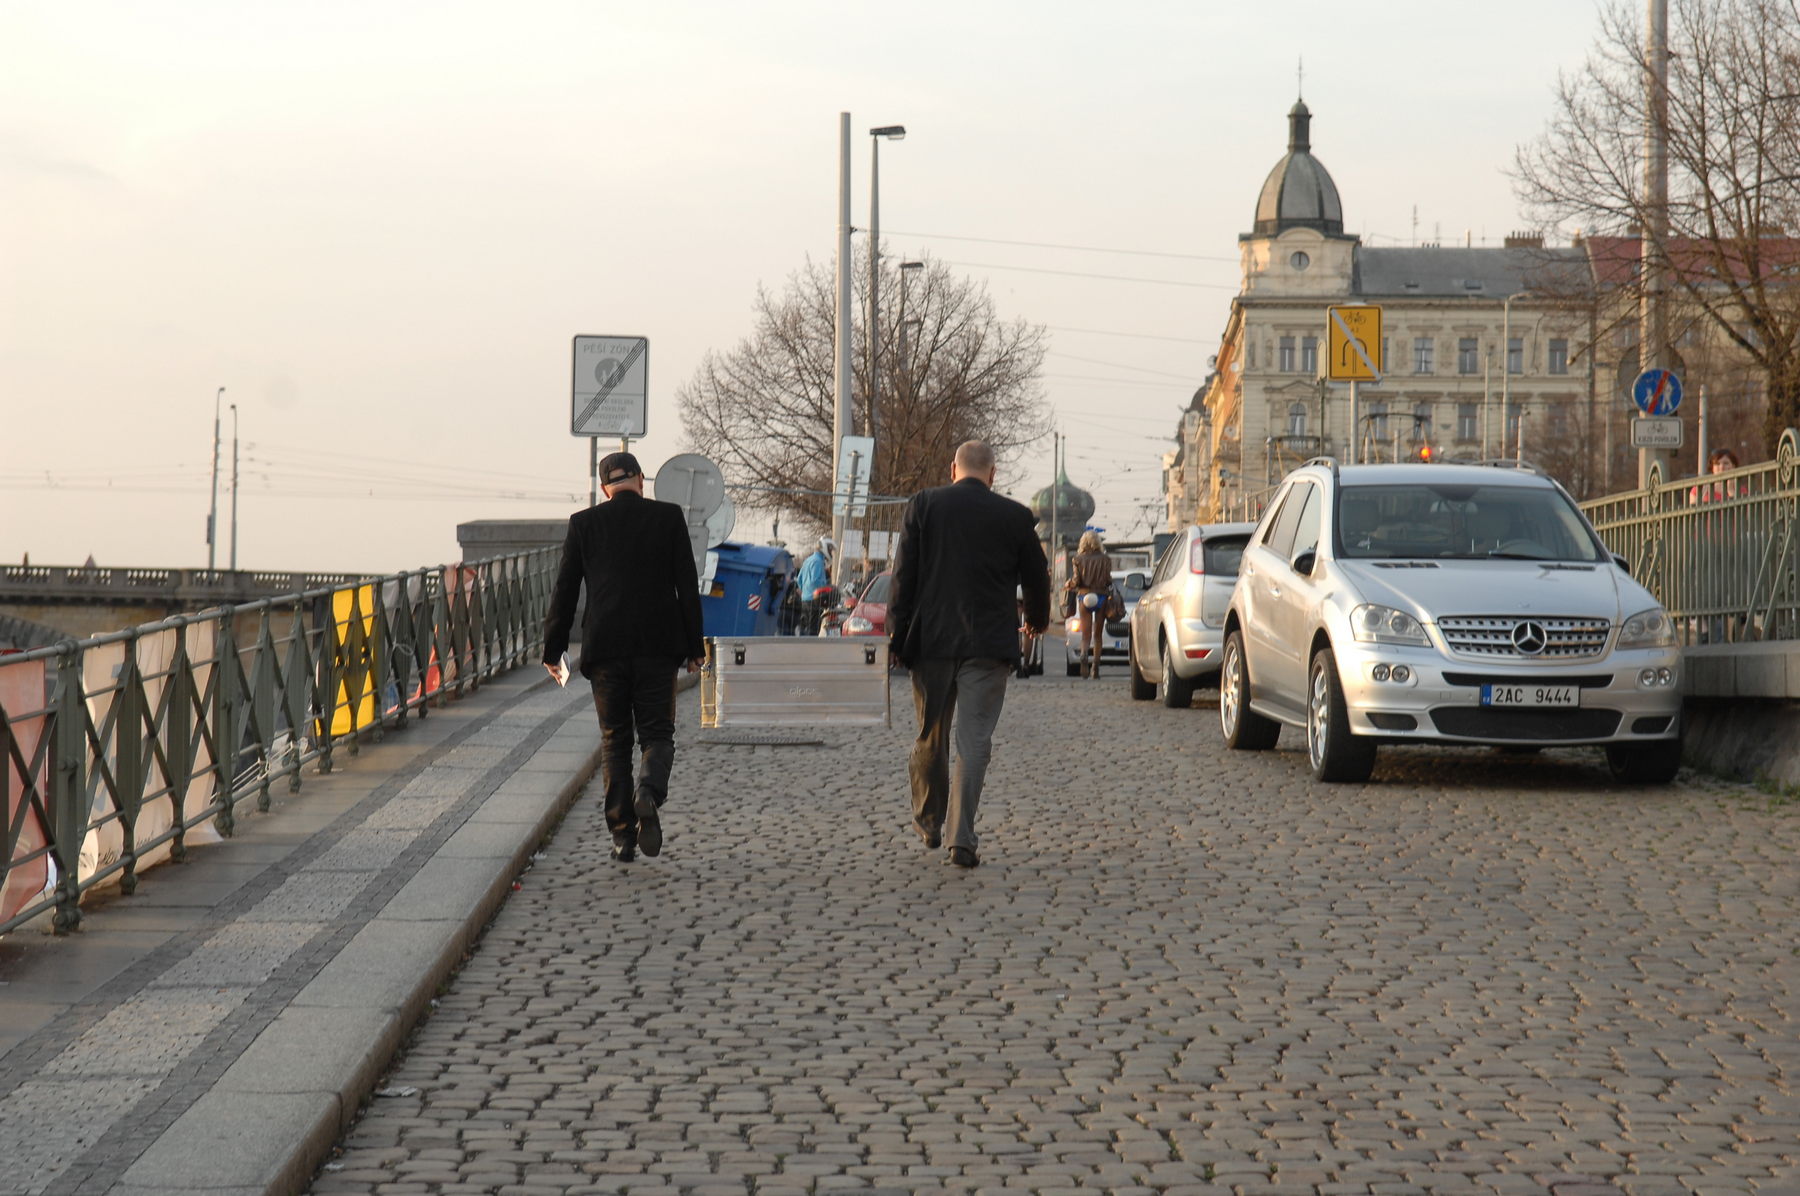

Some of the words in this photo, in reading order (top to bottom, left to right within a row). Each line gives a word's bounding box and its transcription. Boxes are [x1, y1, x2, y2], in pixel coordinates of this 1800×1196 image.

[583, 342, 606, 354] PĚŠÍ
[610, 343, 636, 355] ZÓN
[1495, 687, 1523, 704] 2AC
[1535, 687, 1572, 704] 9444
